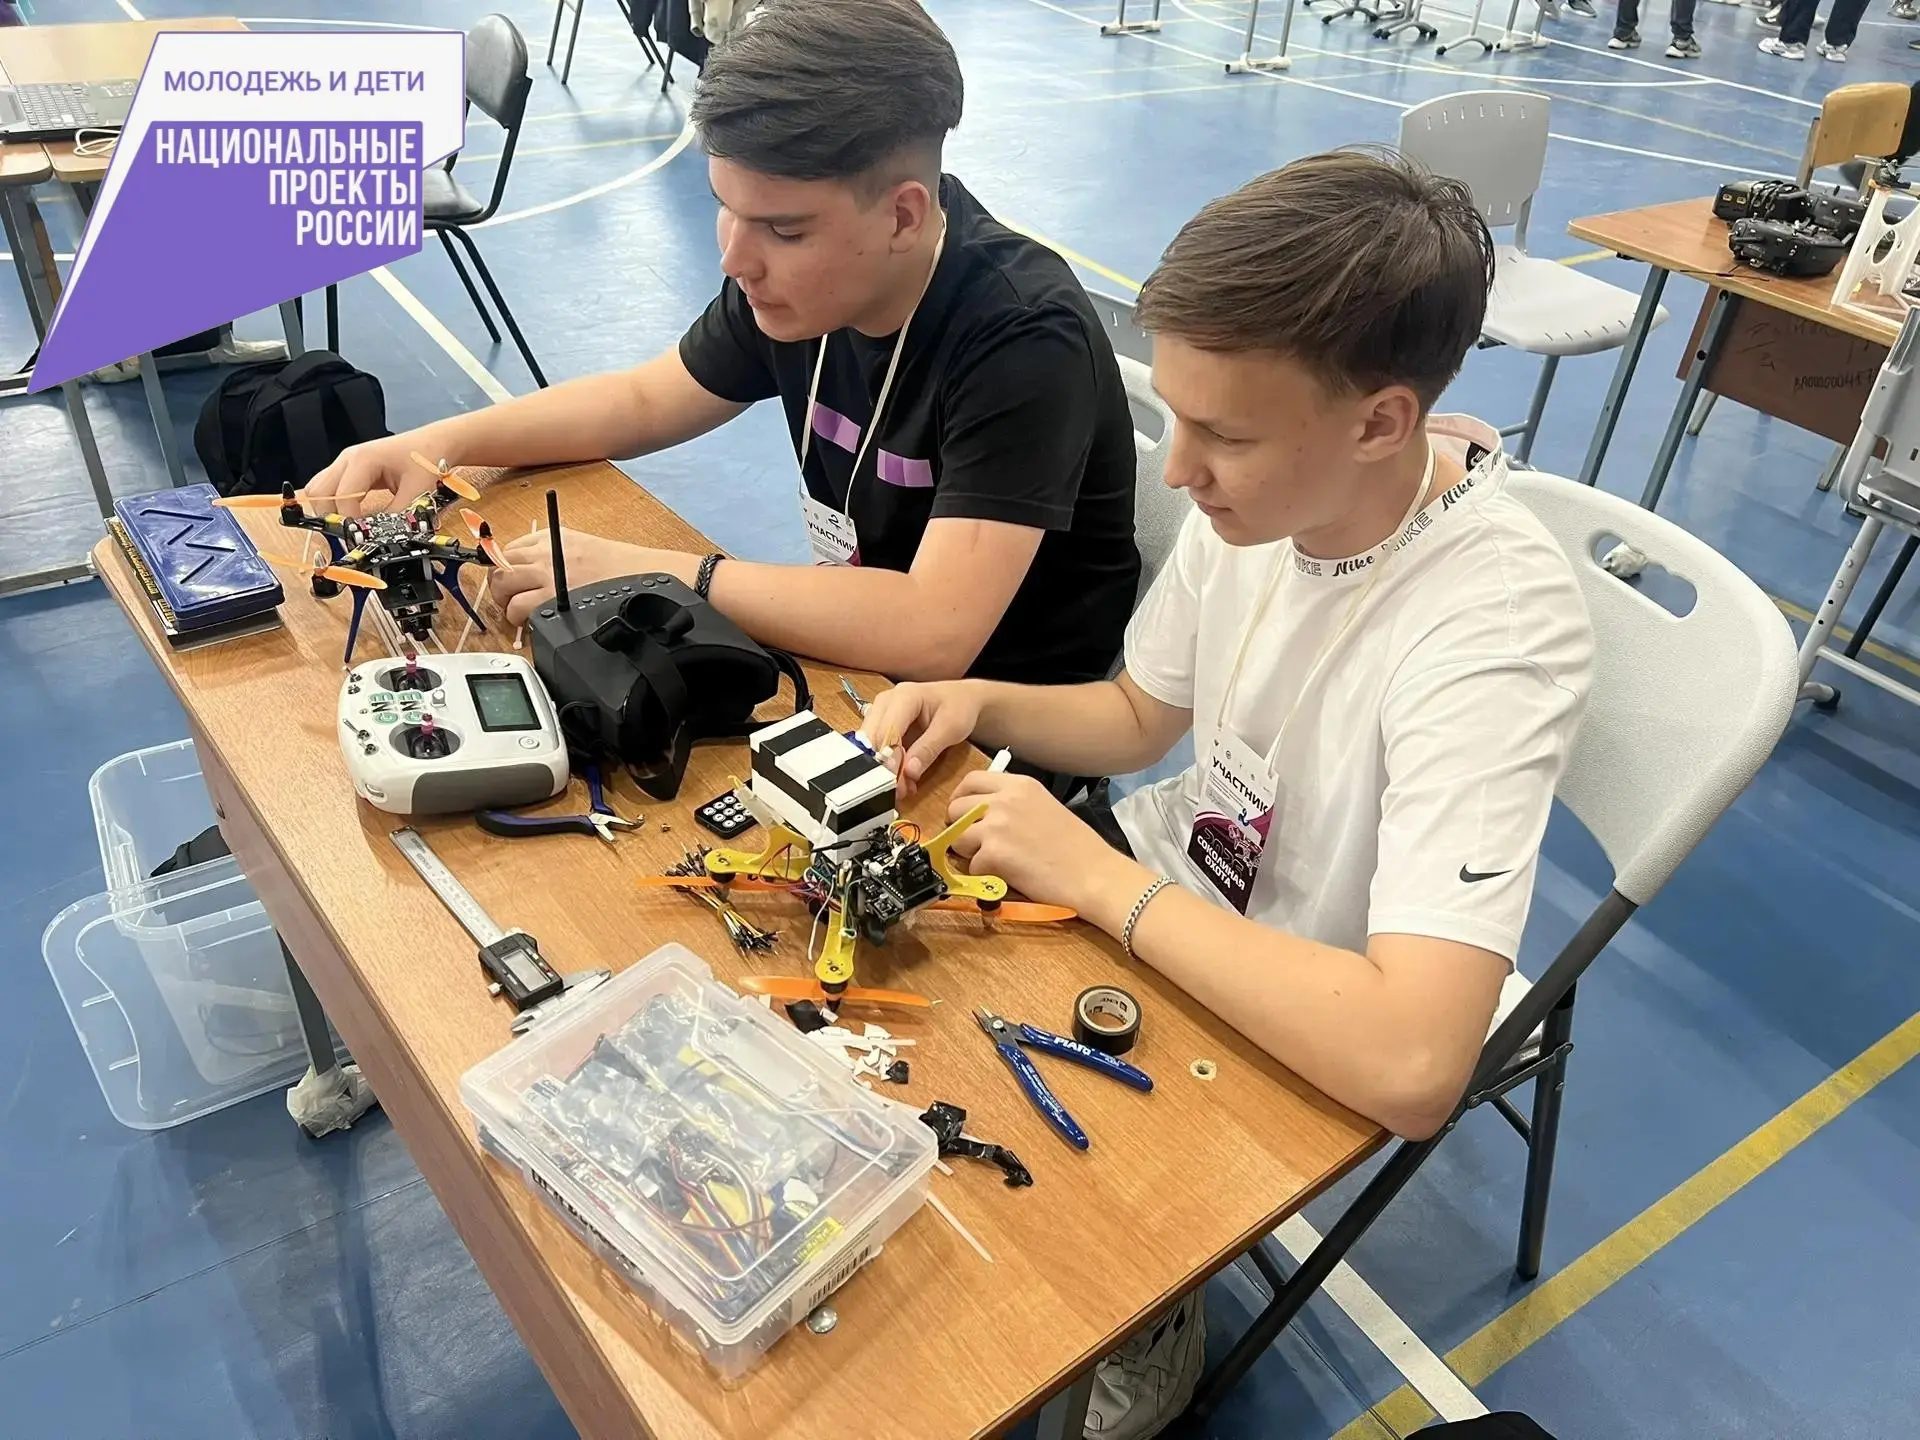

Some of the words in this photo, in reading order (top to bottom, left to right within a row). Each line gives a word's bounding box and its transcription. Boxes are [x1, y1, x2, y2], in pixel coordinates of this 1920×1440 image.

[807, 520, 855, 552] УЧАСТНИК
[1332, 555, 1375, 577] Nike
[1441, 477, 1475, 512] Nike
[1197, 835, 1246, 891] СОКОЛИНАЯ
[1204, 856, 1232, 889] ОХОТА
